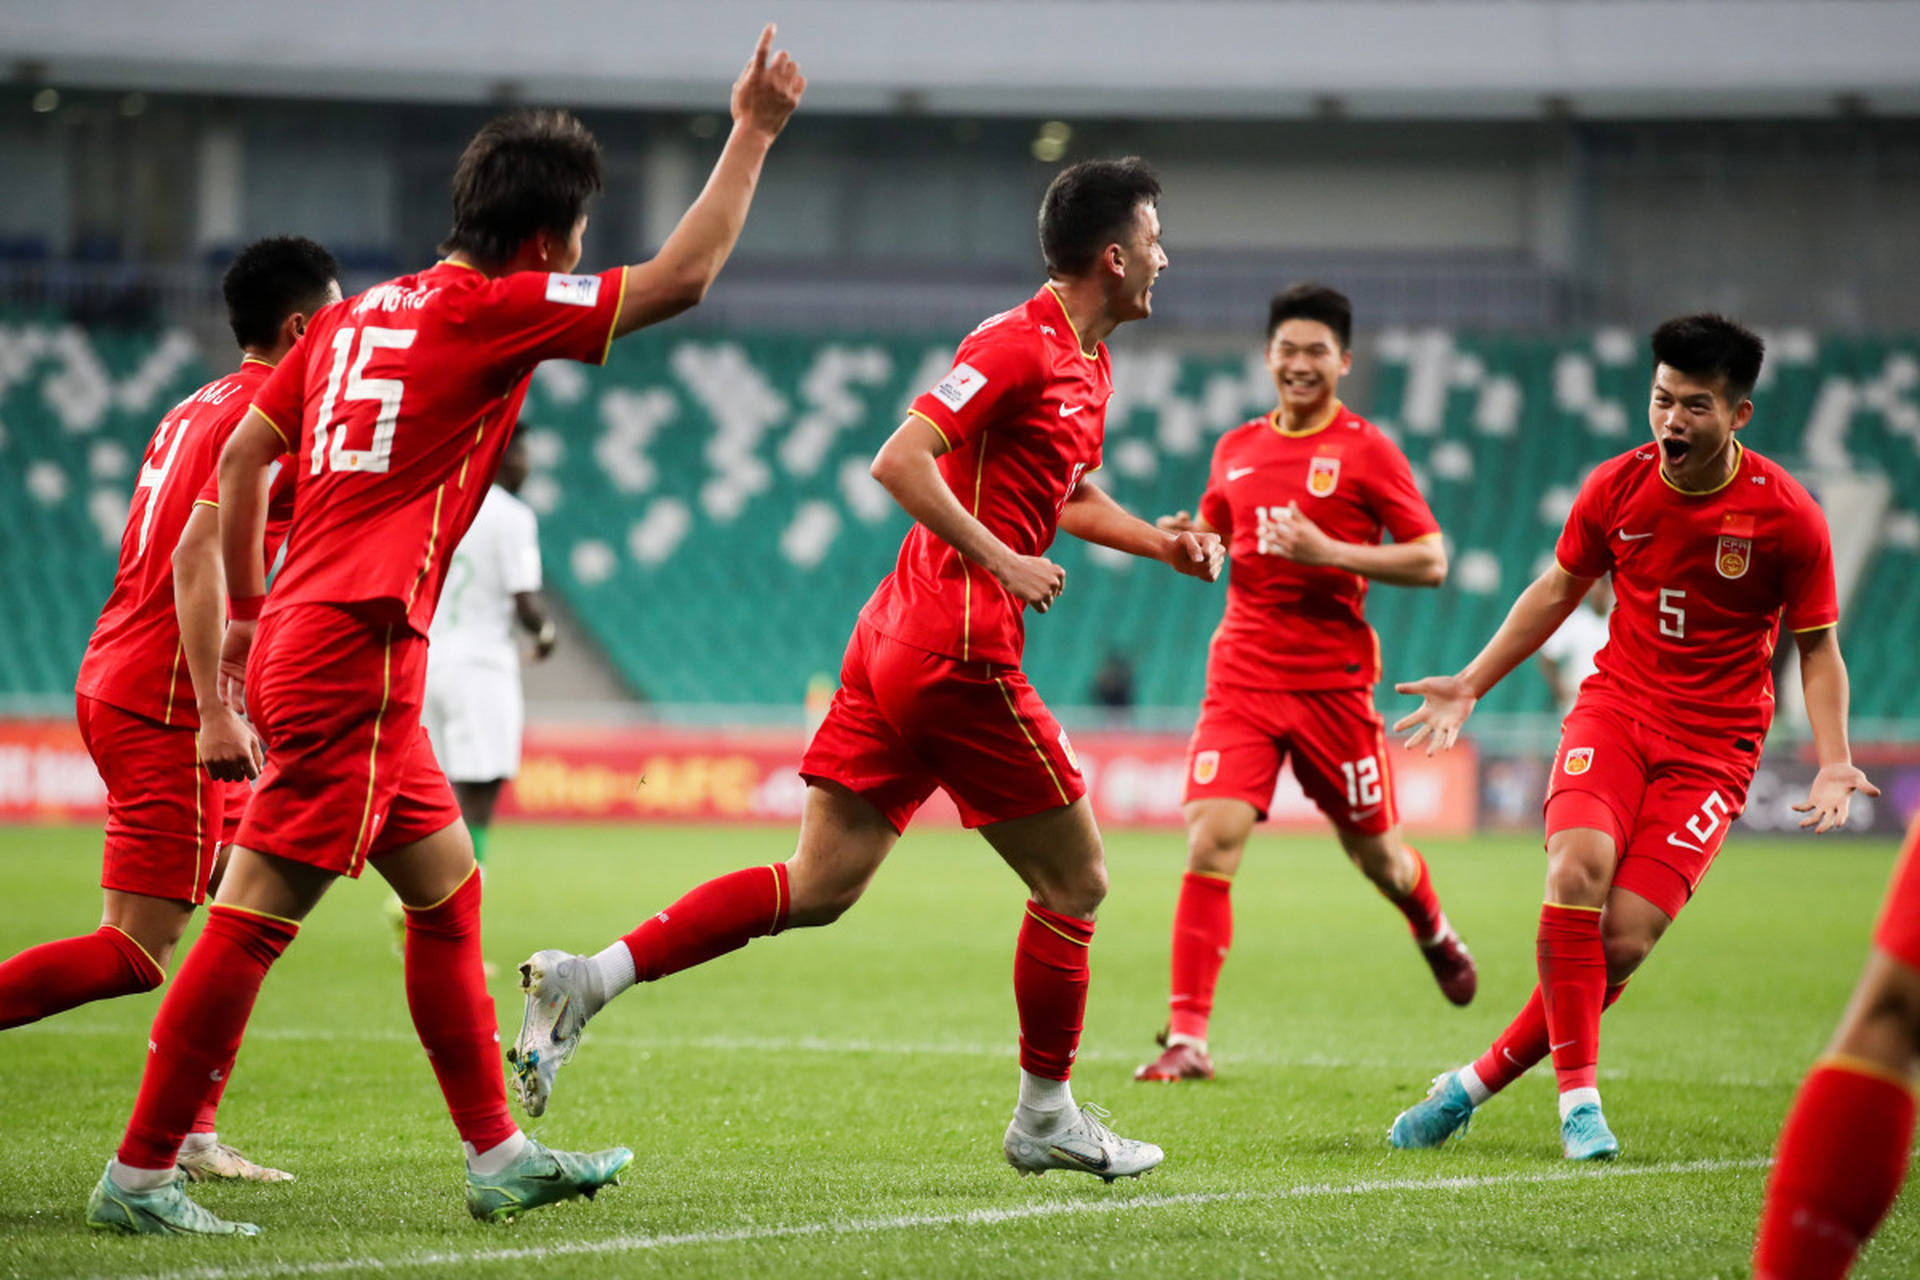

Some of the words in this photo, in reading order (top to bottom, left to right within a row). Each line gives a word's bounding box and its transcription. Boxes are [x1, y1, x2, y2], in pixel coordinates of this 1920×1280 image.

[310, 326, 417, 475] 15
[138, 419, 190, 557] 4
[1659, 588, 1686, 639] 5
[1341, 755, 1383, 807] 12
[1686, 790, 1728, 844] 5
